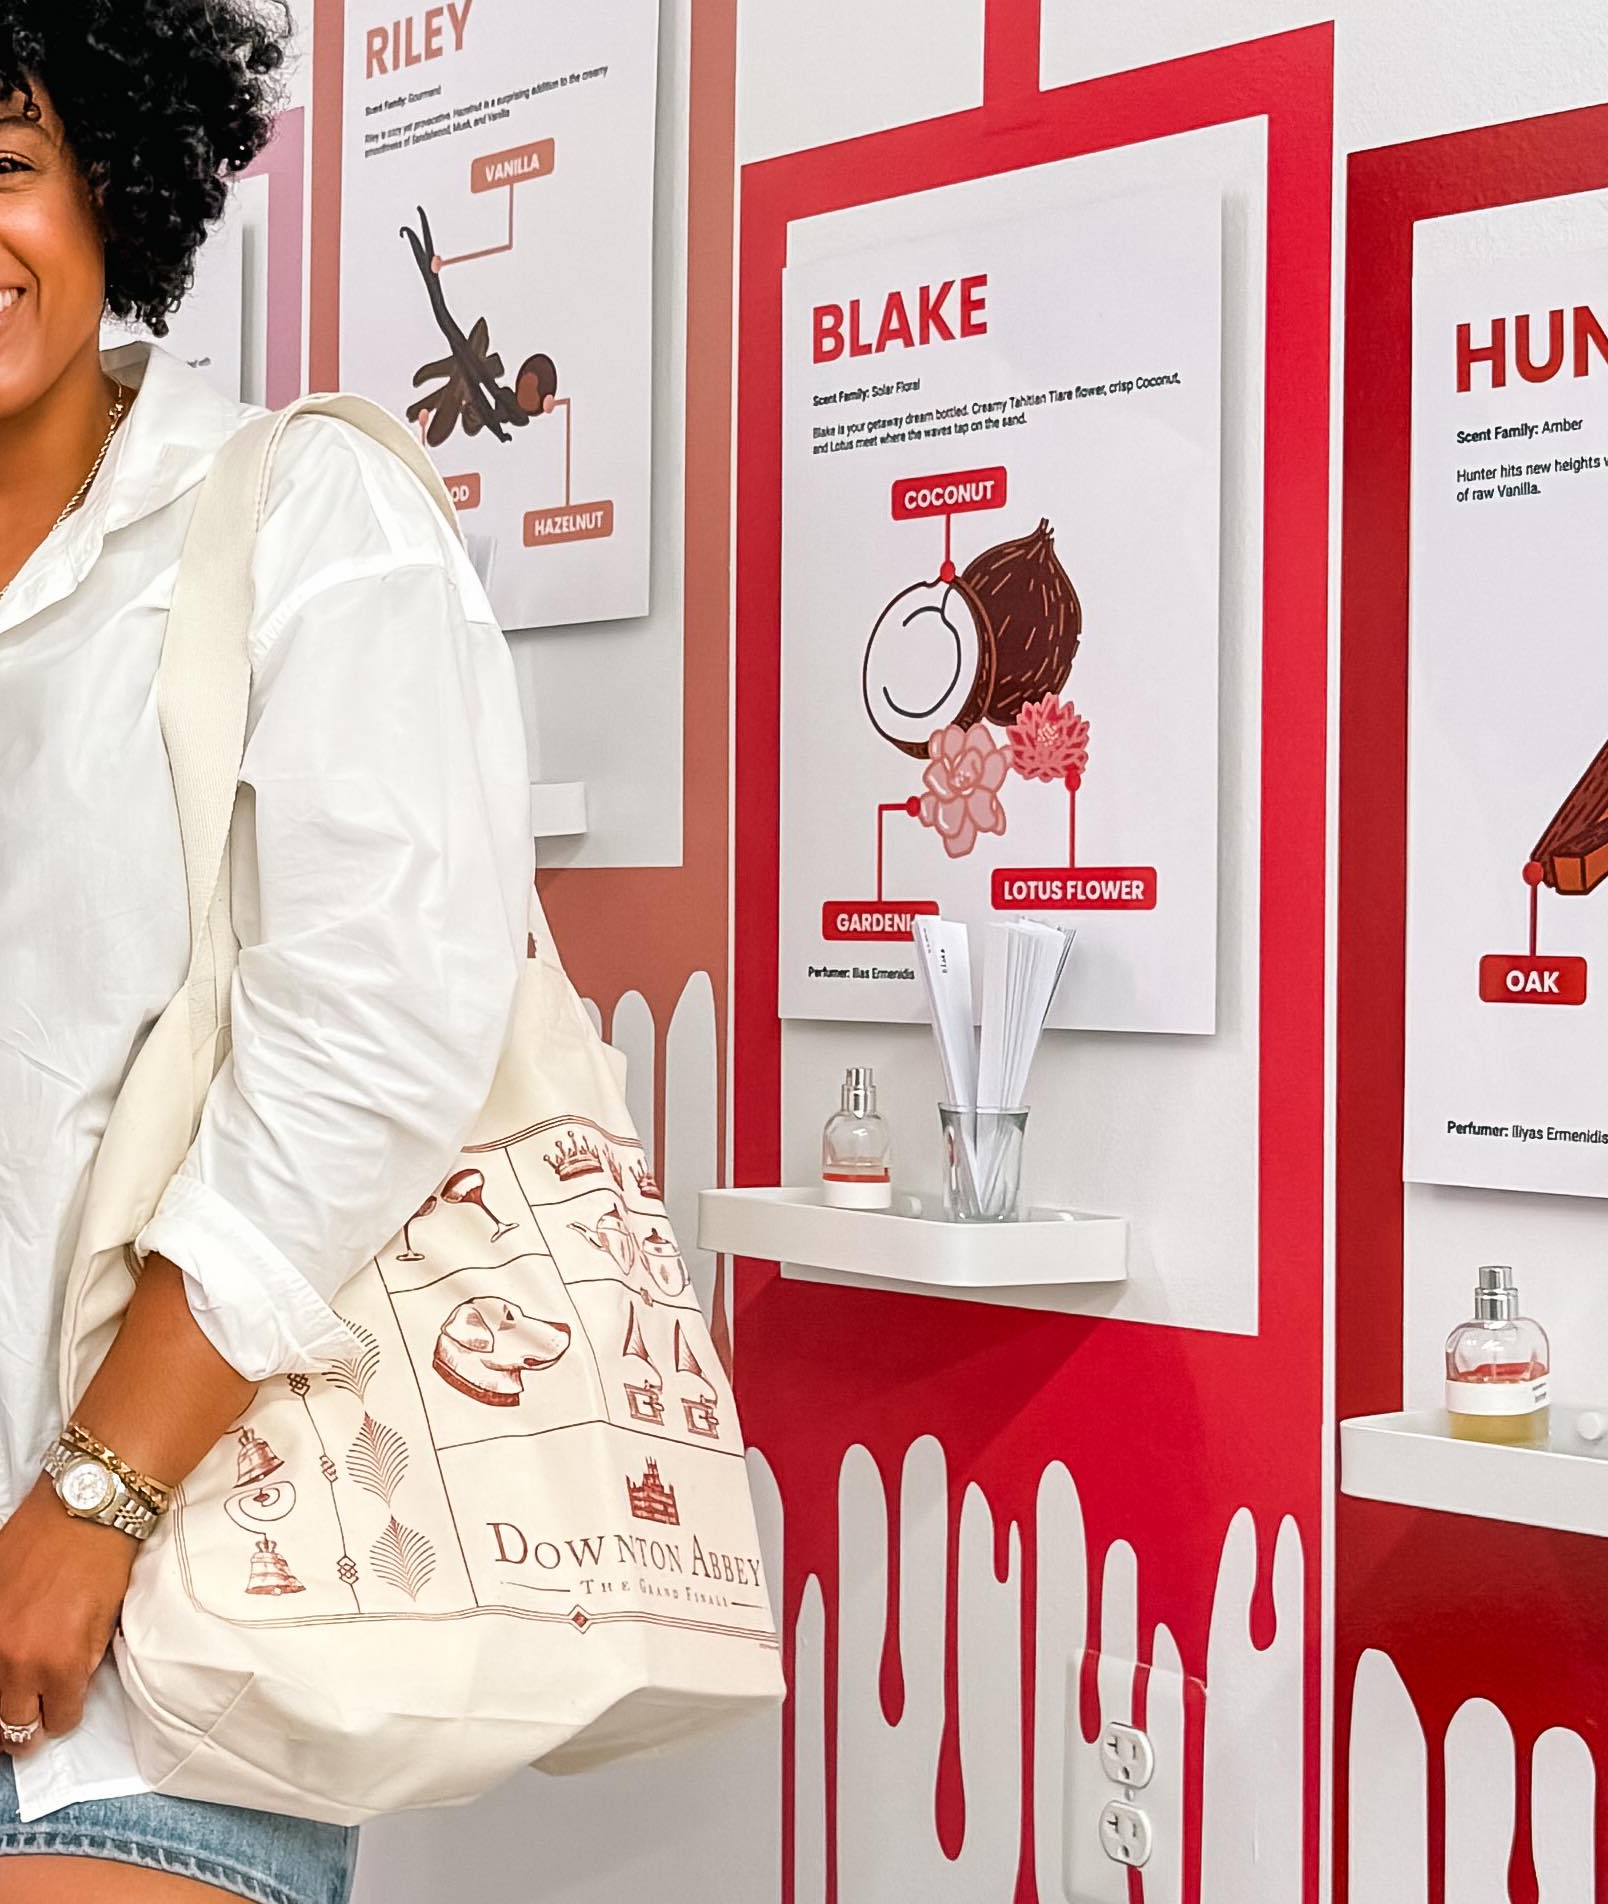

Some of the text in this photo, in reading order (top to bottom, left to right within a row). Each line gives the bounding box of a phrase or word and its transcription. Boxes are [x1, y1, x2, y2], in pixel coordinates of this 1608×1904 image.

[485, 152, 540, 183] VANILLA
[812, 273, 988, 365] BLAKE
[813, 378, 920, 407] Scent Family: Solar Floral
[813, 424, 836, 439] Blake
[847, 421, 866, 437] your
[867, 416, 904, 433] getaway
[905, 410, 934, 425] dream
[935, 404, 969, 421] bottled.
[972, 398, 1008, 415] Creamy
[1008, 393, 1047, 410] Tahitian
[1048, 388, 1073, 404] Tiare
[1075, 383, 1108, 399] flower,
[1108, 379, 1134, 395] crisp
[1135, 371, 1182, 390] Coconut,
[813, 441, 828, 455] and
[830, 438, 854, 453] Lotus
[855, 436, 878, 449] meet
[880, 431, 906, 445] where
[908, 428, 922, 441] the
[924, 424, 952, 438] waves
[971, 420, 983, 432] on
[984, 417, 1000, 431] the
[1002, 412, 1028, 428] sand.
[1456, 417, 1583, 444] Scent Family: Amber
[1456, 456, 1601, 483] Hunter hits new heights
[903, 480, 995, 511] COCONUT
[1456, 481, 1542, 503] of raw Vanilla.
[534, 511, 604, 537] HAZELNUT
[1003, 880, 1144, 900] LOTUS FLOWER
[836, 913, 916, 933] GARDENI
[808, 965, 850, 979] Perfumer:
[871, 967, 915, 981] Ermenidis
[1505, 969, 1559, 995] OAK
[1447, 1120, 1509, 1138] Perfumer:
[1547, 1127, 1608, 1144] Ermenidis
[691, 1533, 761, 1588] ABBEY
